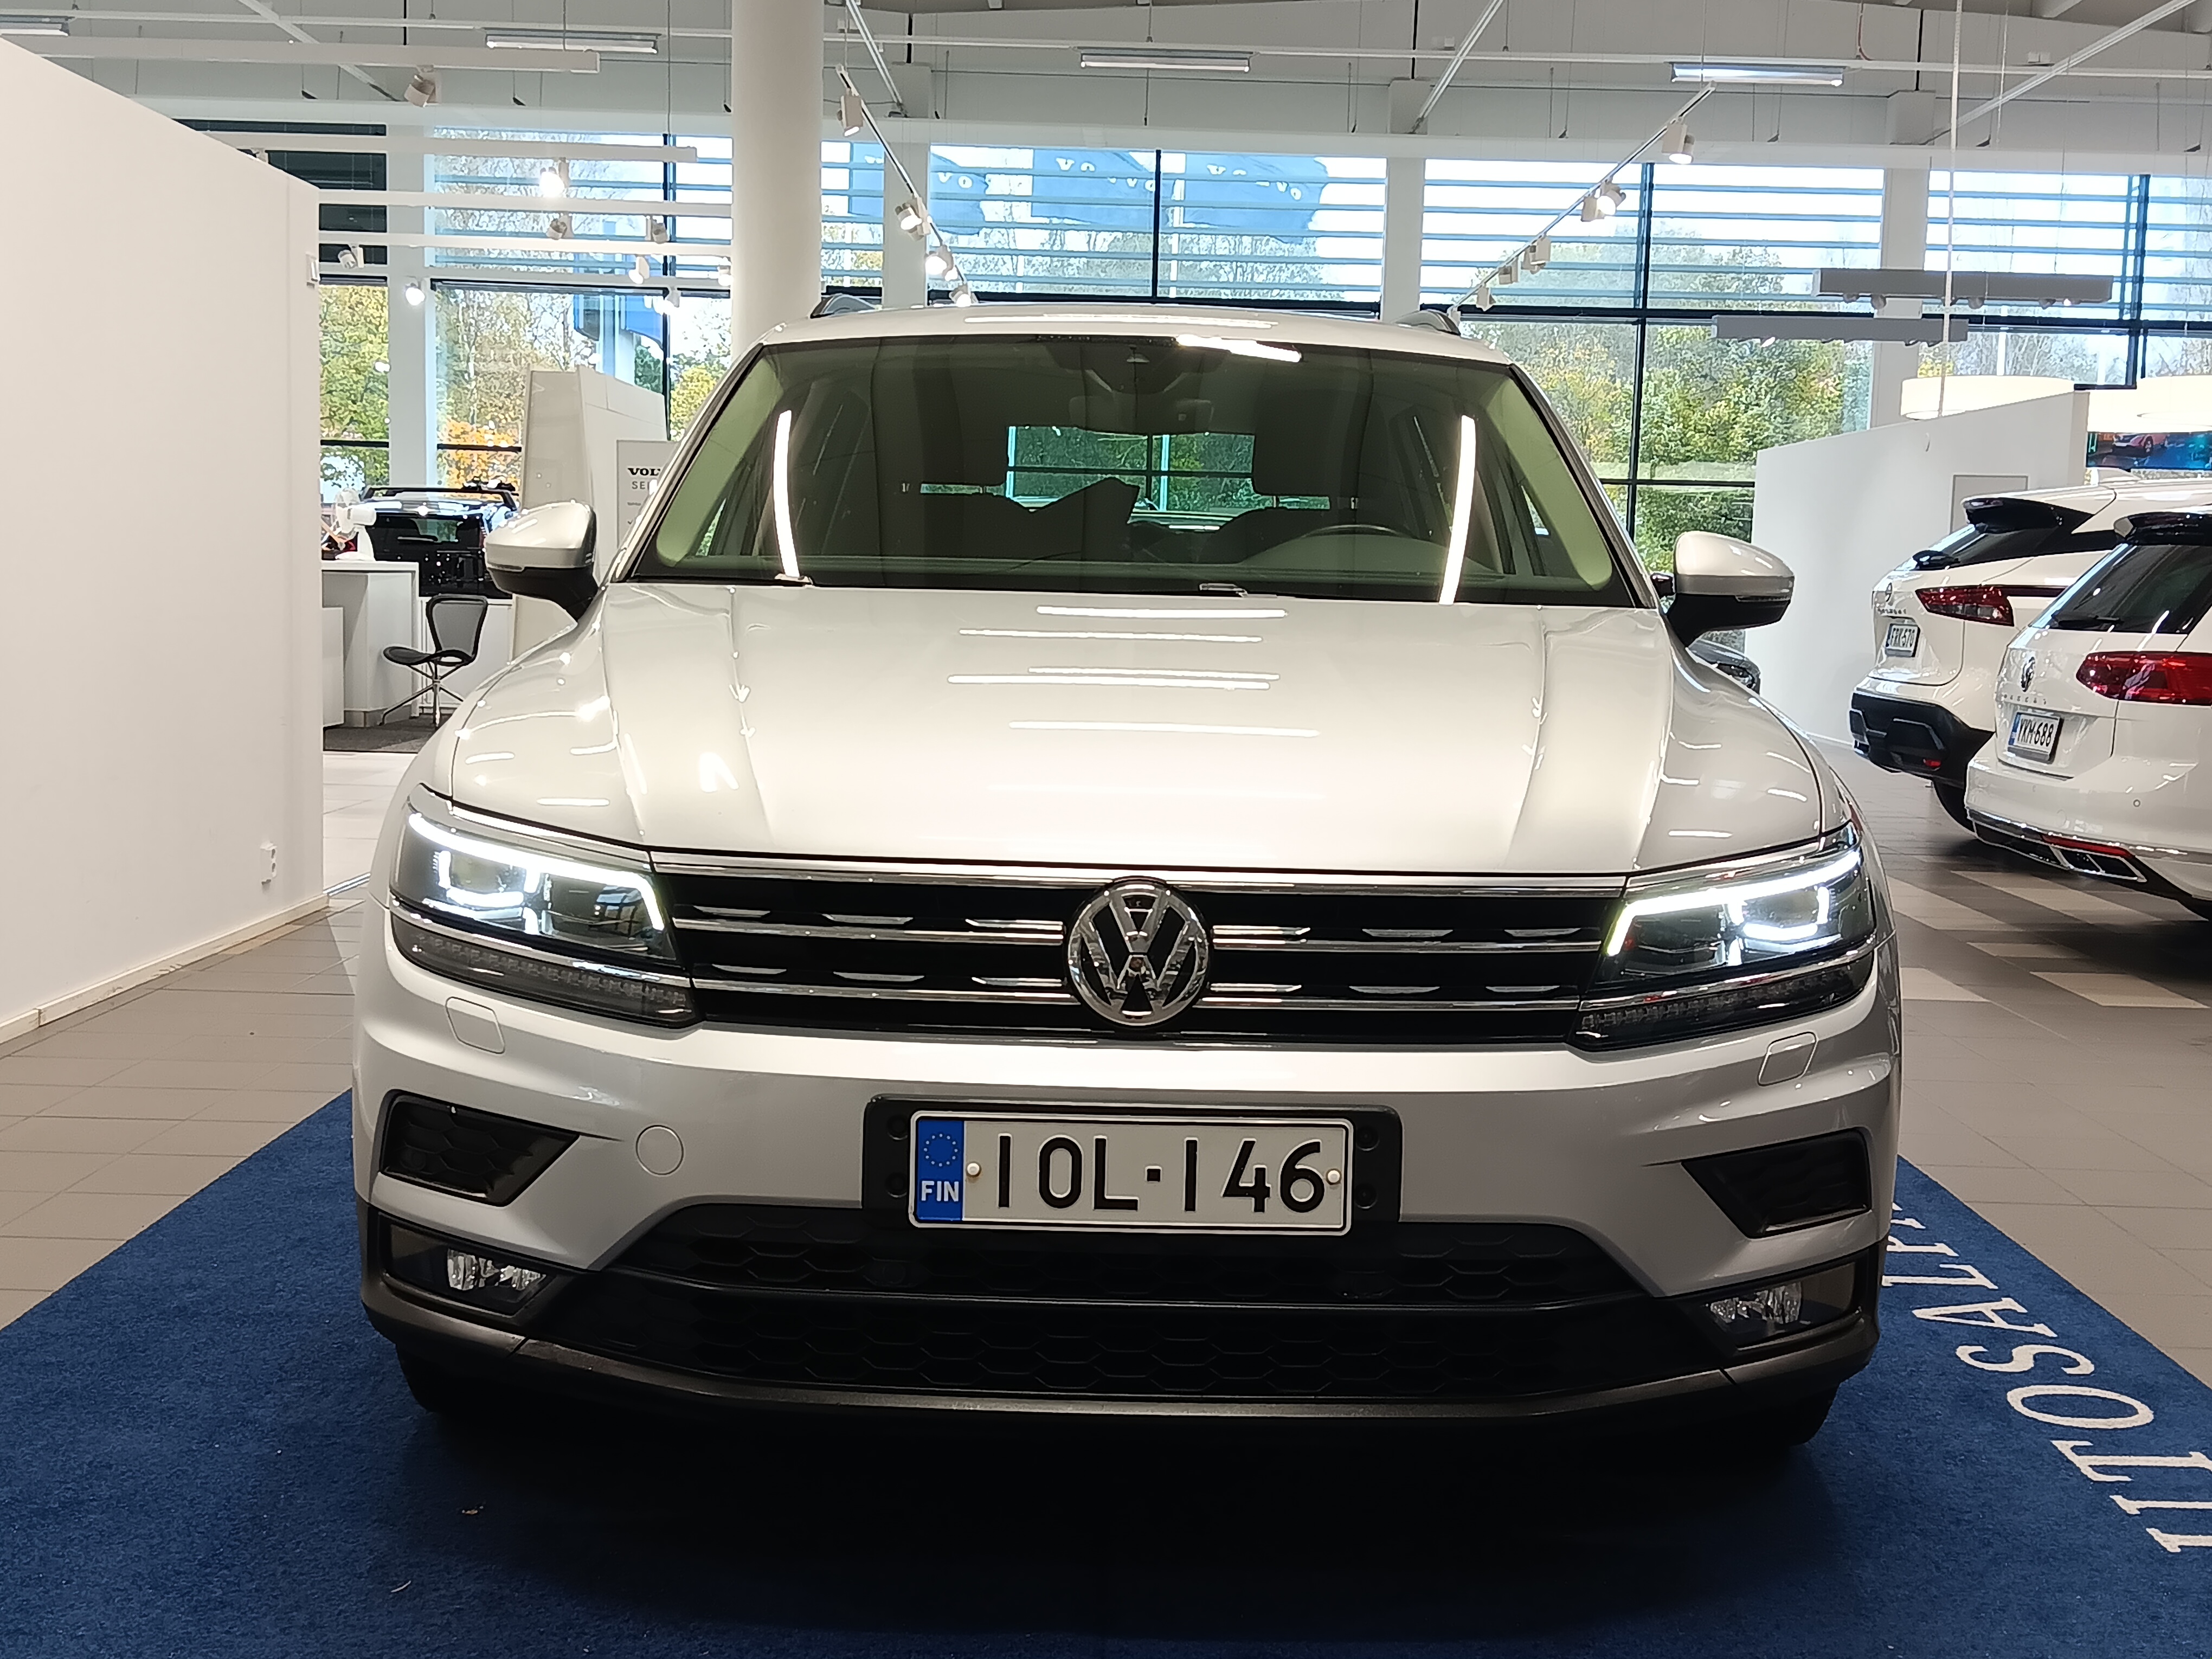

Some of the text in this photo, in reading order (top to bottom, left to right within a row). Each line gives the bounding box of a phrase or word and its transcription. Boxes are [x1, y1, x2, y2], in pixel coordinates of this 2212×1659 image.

[627, 467, 660, 476] VOL
[632, 481, 650, 490] SE
[921, 1180, 959, 1203] FIN
